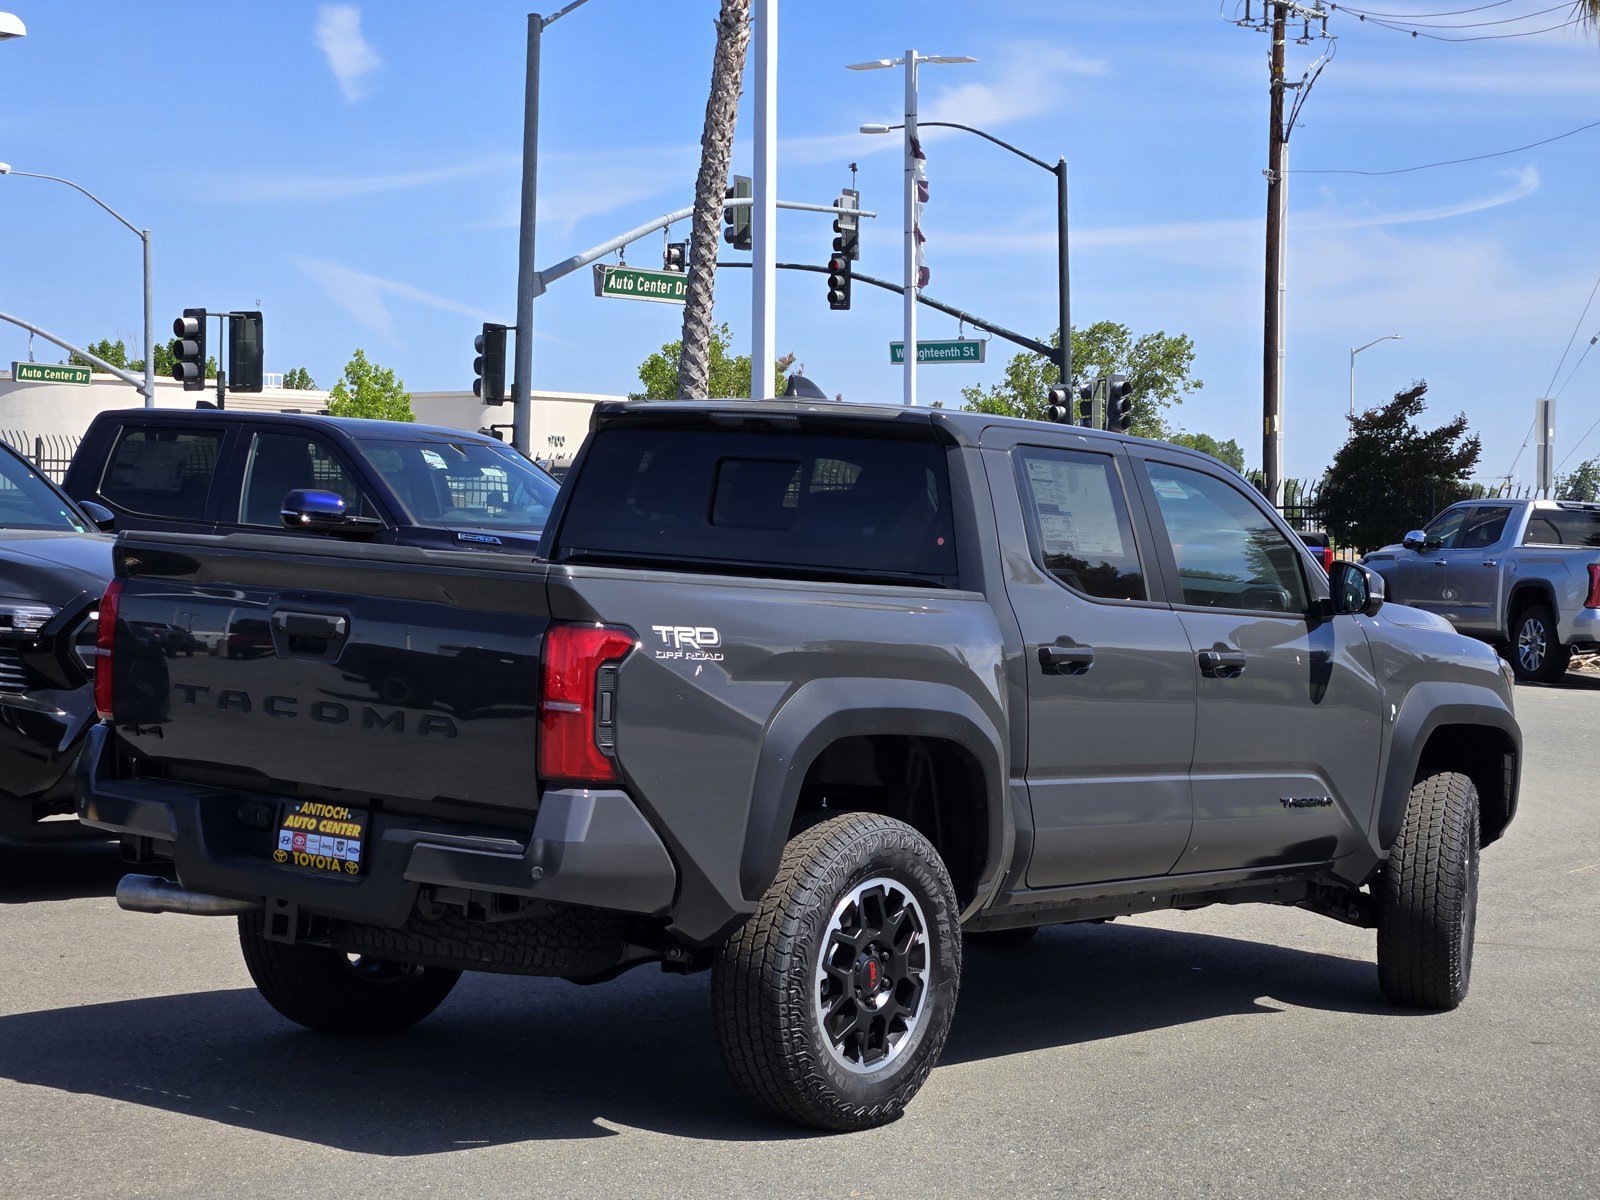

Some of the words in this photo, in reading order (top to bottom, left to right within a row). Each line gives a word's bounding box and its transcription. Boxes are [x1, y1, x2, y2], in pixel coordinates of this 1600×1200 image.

[609, 275, 634, 290] Auto
[637, 277, 672, 294] Center
[675, 281, 688, 295] Dr
[916, 347, 960, 360] ighteenth
[963, 346, 974, 357] St
[21, 368, 42, 378] Auto
[44, 369, 74, 380] Center
[76, 372, 87, 381] Dr
[652, 625, 720, 650] TRD
[685, 651, 724, 661] ROAD
[173, 683, 458, 739] TACOMA
[300, 801, 349, 820] ANTIOCH
[284, 814, 317, 831] AUTO
[319, 819, 362, 838] CENTER
[293, 851, 341, 872] TOYOTA
